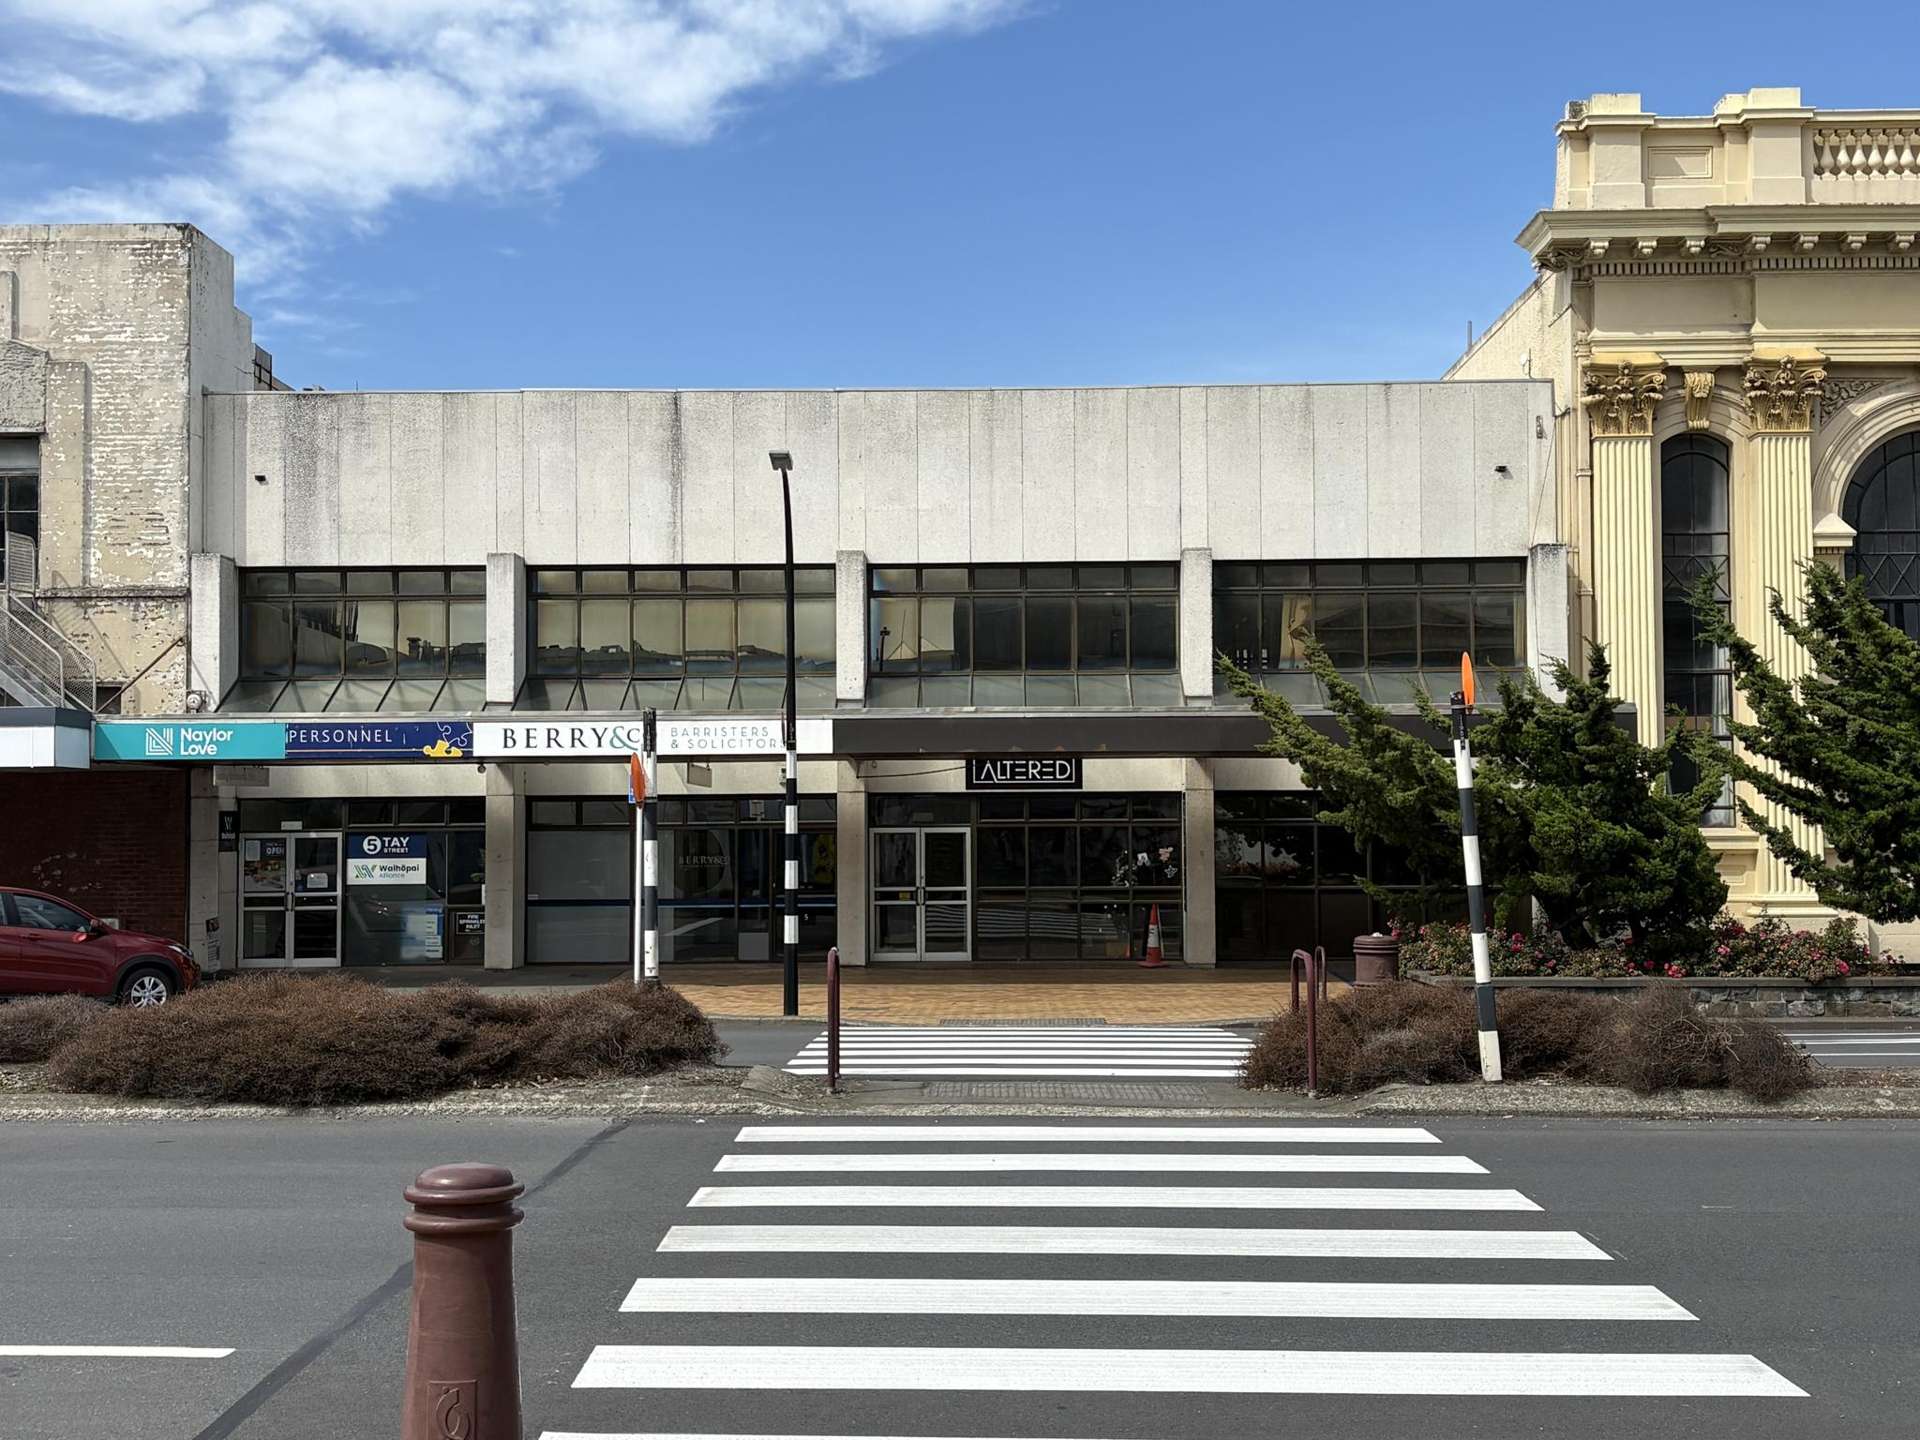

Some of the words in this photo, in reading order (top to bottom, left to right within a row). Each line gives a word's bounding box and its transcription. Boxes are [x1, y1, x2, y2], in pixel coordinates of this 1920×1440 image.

[180, 727, 234, 743] Naylor
[289, 728, 393, 743] PERSONNEL
[502, 725, 641, 751] BERRY&C
[670, 726, 769, 737] BARRISTERS
[180, 740, 217, 756] Love
[670, 738, 679, 749] &
[980, 759, 1071, 783] ALTERED
[366, 837, 379, 853] 5
[382, 836, 410, 848] TAY
